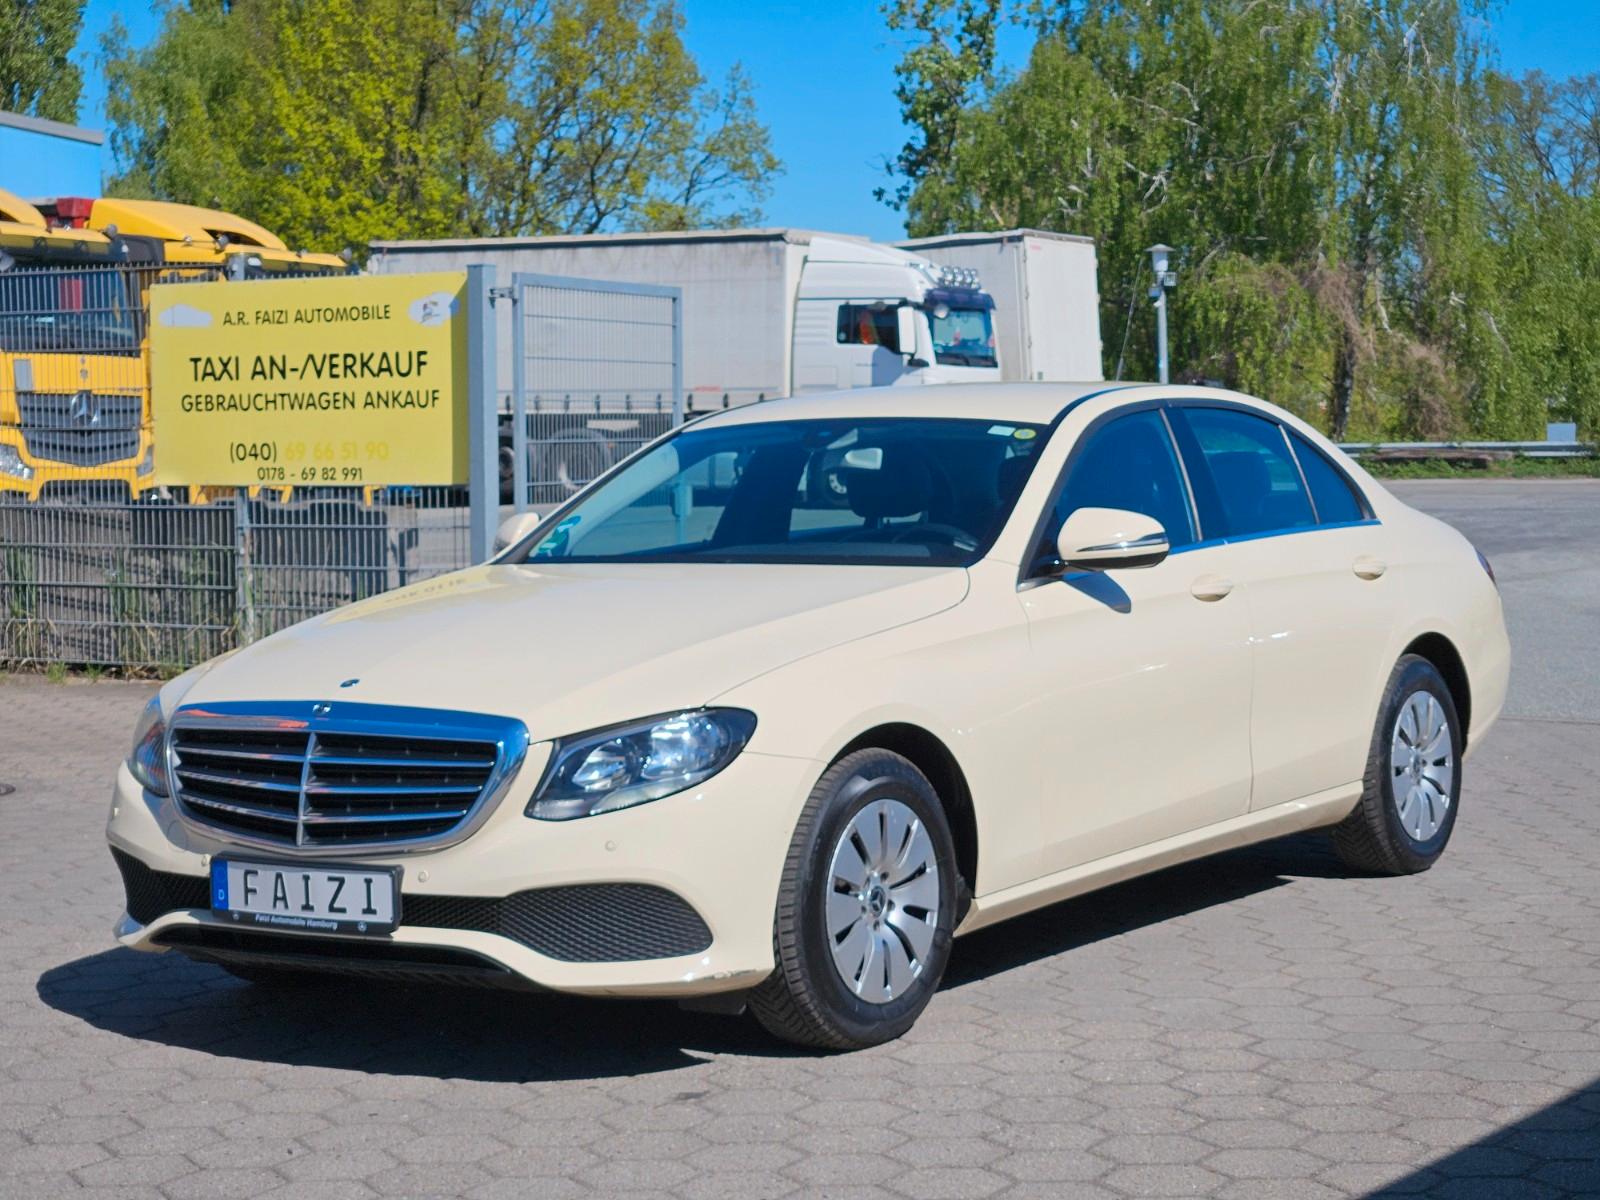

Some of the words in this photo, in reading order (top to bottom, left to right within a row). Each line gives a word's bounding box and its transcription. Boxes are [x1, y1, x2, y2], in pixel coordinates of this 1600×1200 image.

[223, 311, 249, 326] A.R.
[255, 309, 289, 325] FAIZI
[294, 305, 391, 323] AUTOMOBILE
[190, 356, 240, 382] TAXI
[181, 391, 356, 413] GEBRAUCHTWAGEN
[363, 390, 440, 410] ANKAUF
[230, 442, 278, 463] (040)
[257, 467, 285, 481] 0178
[301, 467, 317, 481] 69
[322, 467, 337, 481] 82
[342, 467, 363, 481] 991
[218, 889, 225, 900] D
[243, 869, 378, 915] FAIZI
